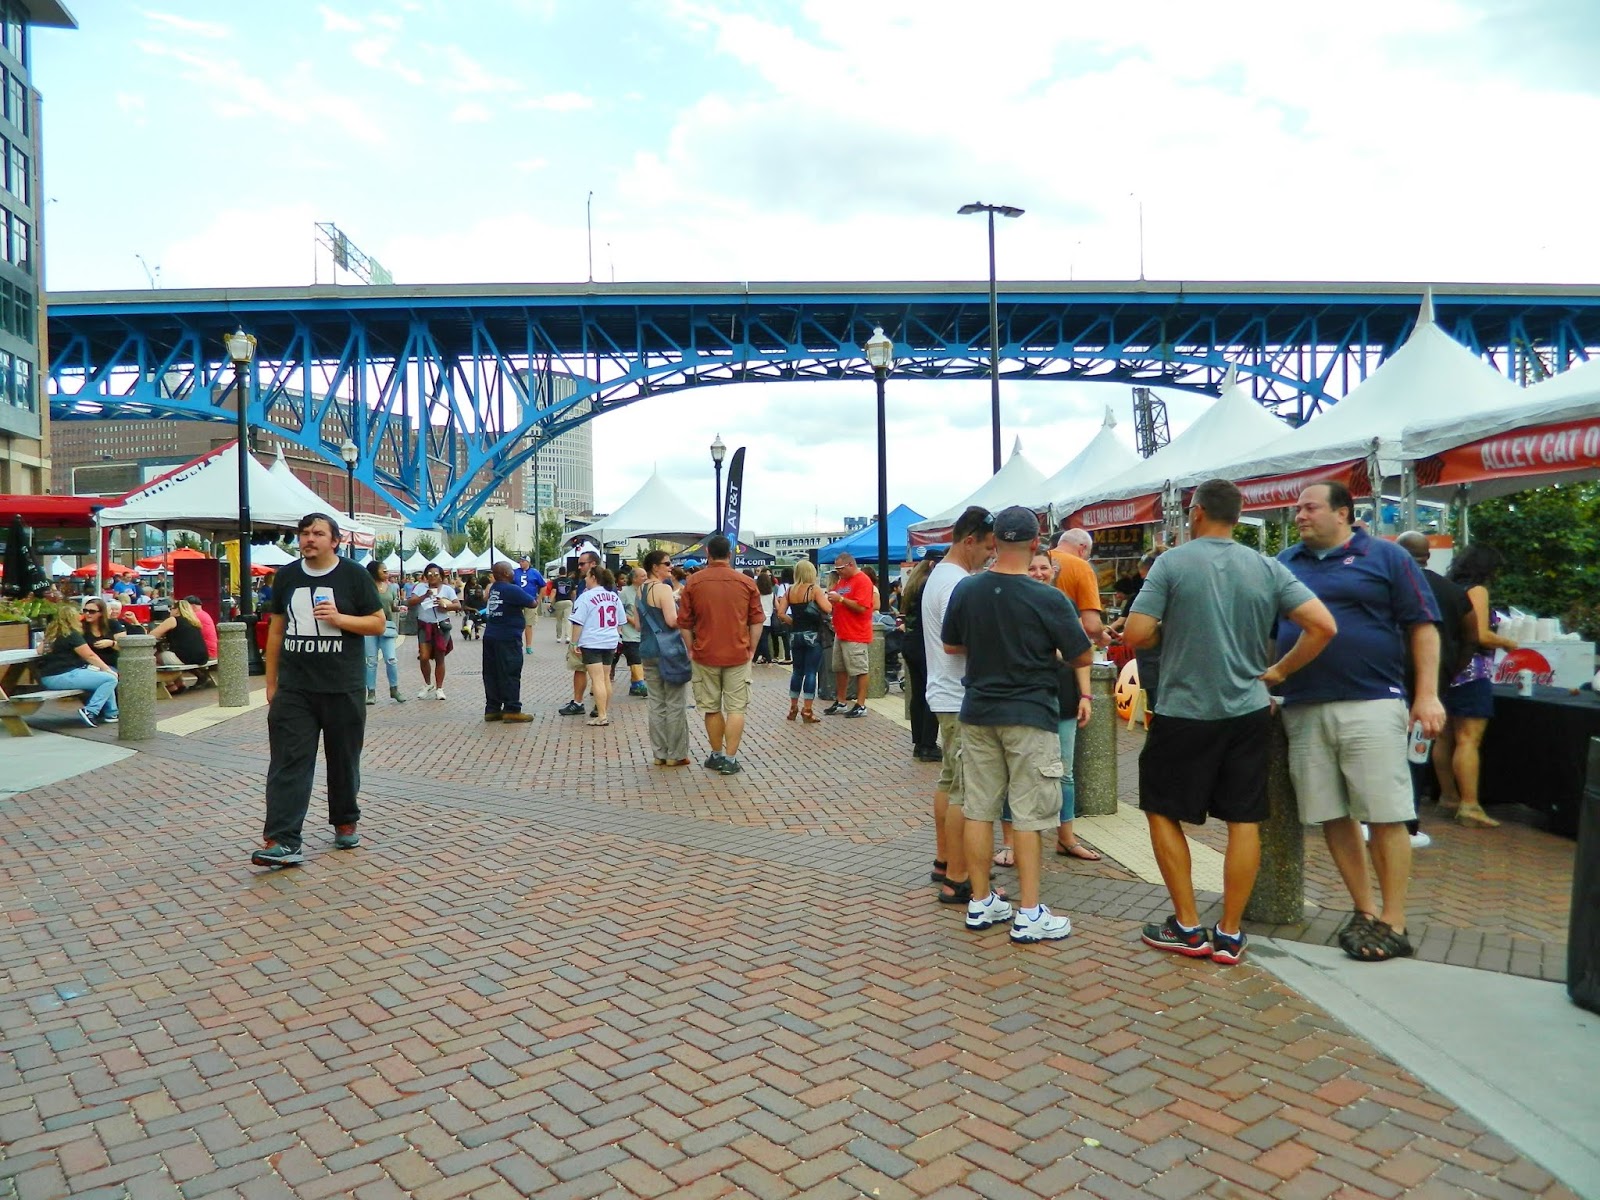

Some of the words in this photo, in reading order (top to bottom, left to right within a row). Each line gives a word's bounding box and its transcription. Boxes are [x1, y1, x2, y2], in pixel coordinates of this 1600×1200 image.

[1480, 435, 1538, 471] ALLEY
[1540, 428, 1581, 464] CAT
[1244, 484, 1276, 505] SWEET
[727, 481, 739, 529] AT&T
[1082, 509, 1097, 526] MELT
[1097, 506, 1108, 525] BAR
[1094, 528, 1141, 544] MELT
[735, 557, 766, 565] 04.com
[520, 575, 528, 588] 5
[598, 605, 617, 628] 13
